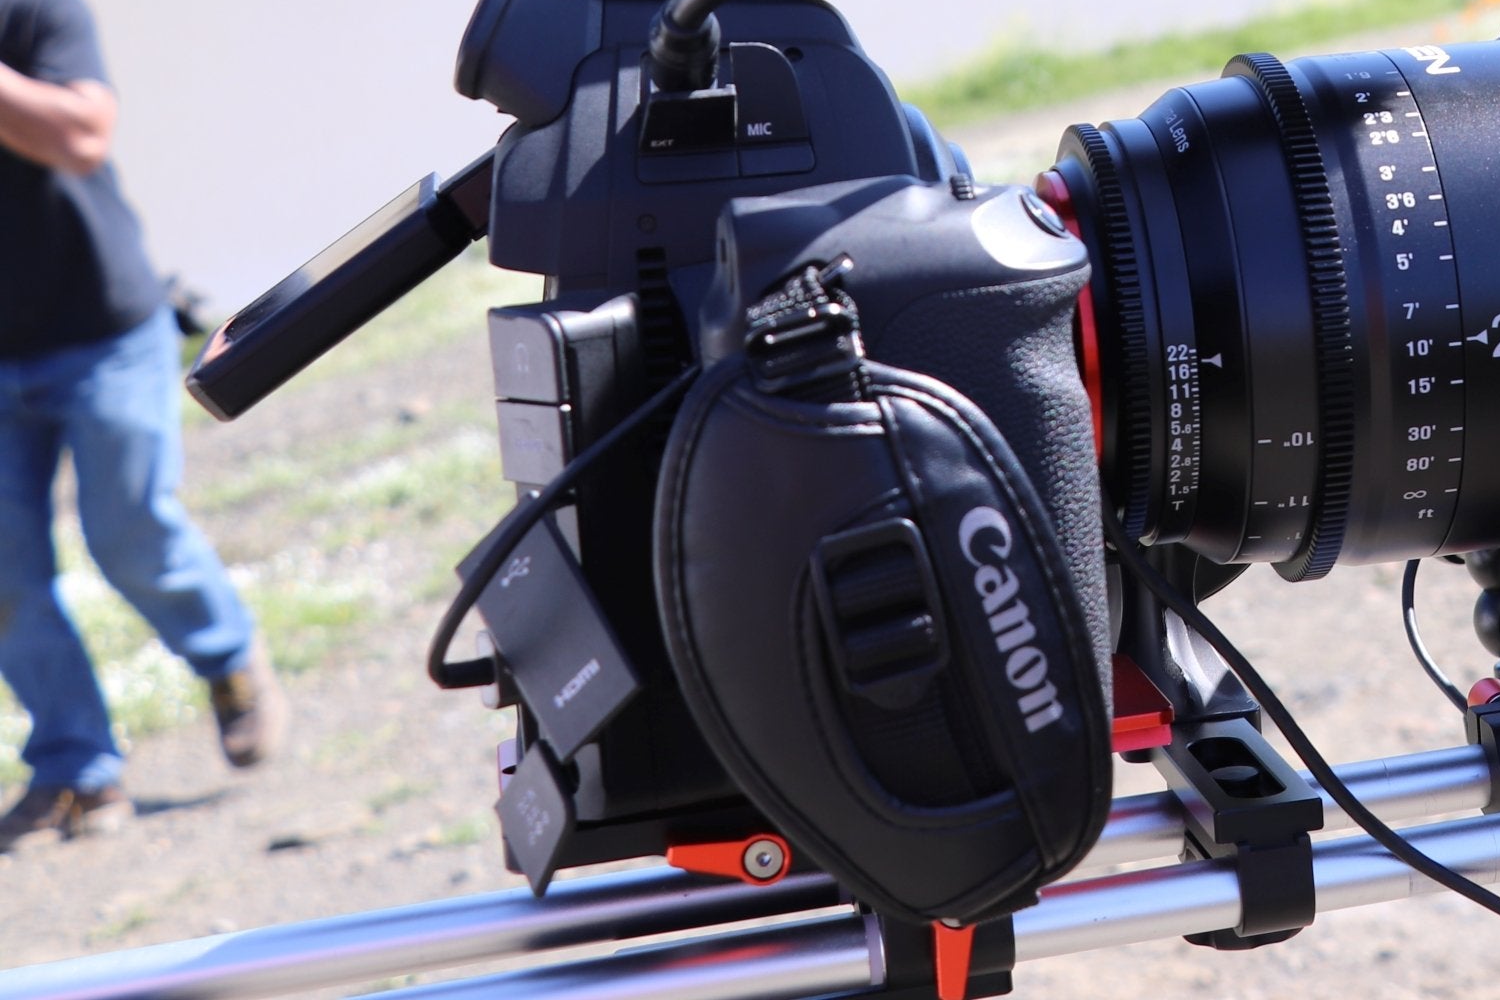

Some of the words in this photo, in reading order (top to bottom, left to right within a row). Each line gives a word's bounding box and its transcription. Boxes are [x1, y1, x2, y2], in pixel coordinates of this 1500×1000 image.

[1355, 92, 1370, 102] 2'
[747, 122, 772, 136] MIC
[1169, 118, 1189, 152] Lens
[1369, 130, 1399, 145] 2'6
[1379, 165, 1396, 181] 3'
[1385, 192, 1415, 209] 3'6
[1392, 219, 1408, 235] 4'
[1396, 253, 1413, 270] 5'
[1402, 302, 1420, 319] 7'
[1167, 344, 1188, 361] 22
[1406, 339, 1433, 356] 10'
[1168, 363, 1190, 380] 16
[1169, 383, 1189, 400] 11
[1408, 377, 1435, 394] 15'
[1171, 403, 1182, 418] 8
[1171, 420, 1192, 435] 5.6
[1408, 425, 1436, 441] 30'
[1171, 438, 1183, 451] 4
[1171, 455, 1191, 468] 2.8
[1406, 456, 1434, 471] 80'
[1170, 470, 1181, 482] 2
[1170, 484, 1190, 495] 1.5
[1171, 500, 1184, 511] T
[1418, 508, 1434, 519] ft
[958, 506, 1064, 733] Canon
